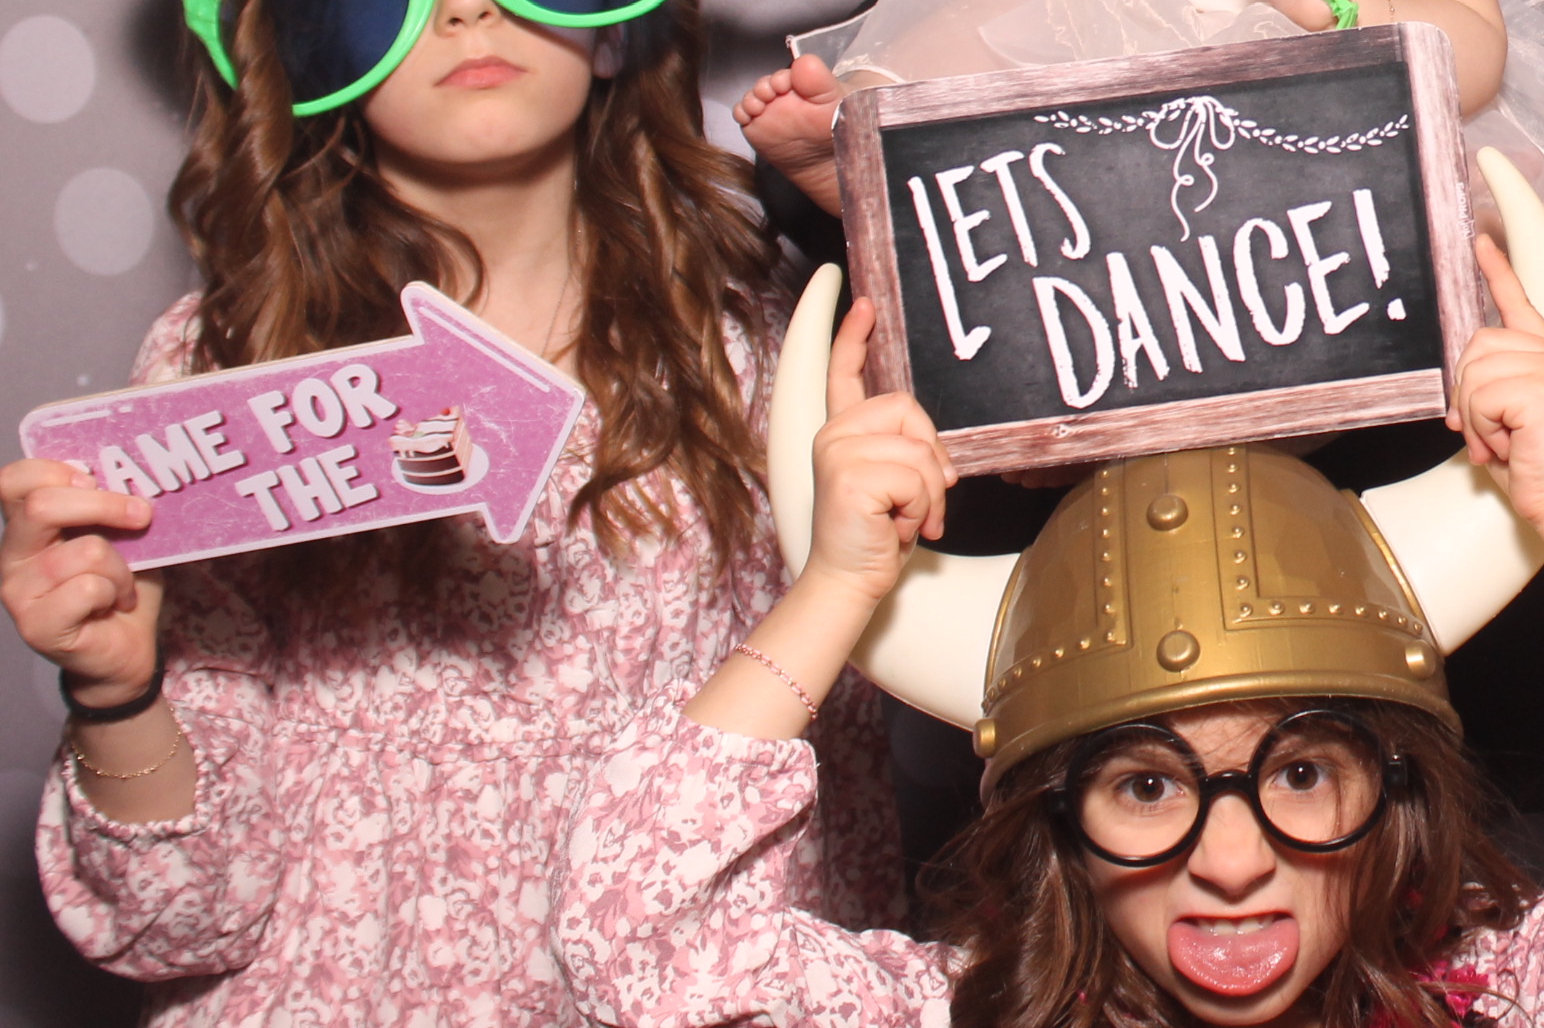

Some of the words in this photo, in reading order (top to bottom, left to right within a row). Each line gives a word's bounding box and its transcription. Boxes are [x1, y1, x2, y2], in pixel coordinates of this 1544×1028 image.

[908, 143, 1091, 361] LETS
[1033, 188, 1407, 409] DANCE!
[64, 410, 246, 498] AME
[247, 363, 399, 455] FOR
[234, 444, 379, 532] THE
